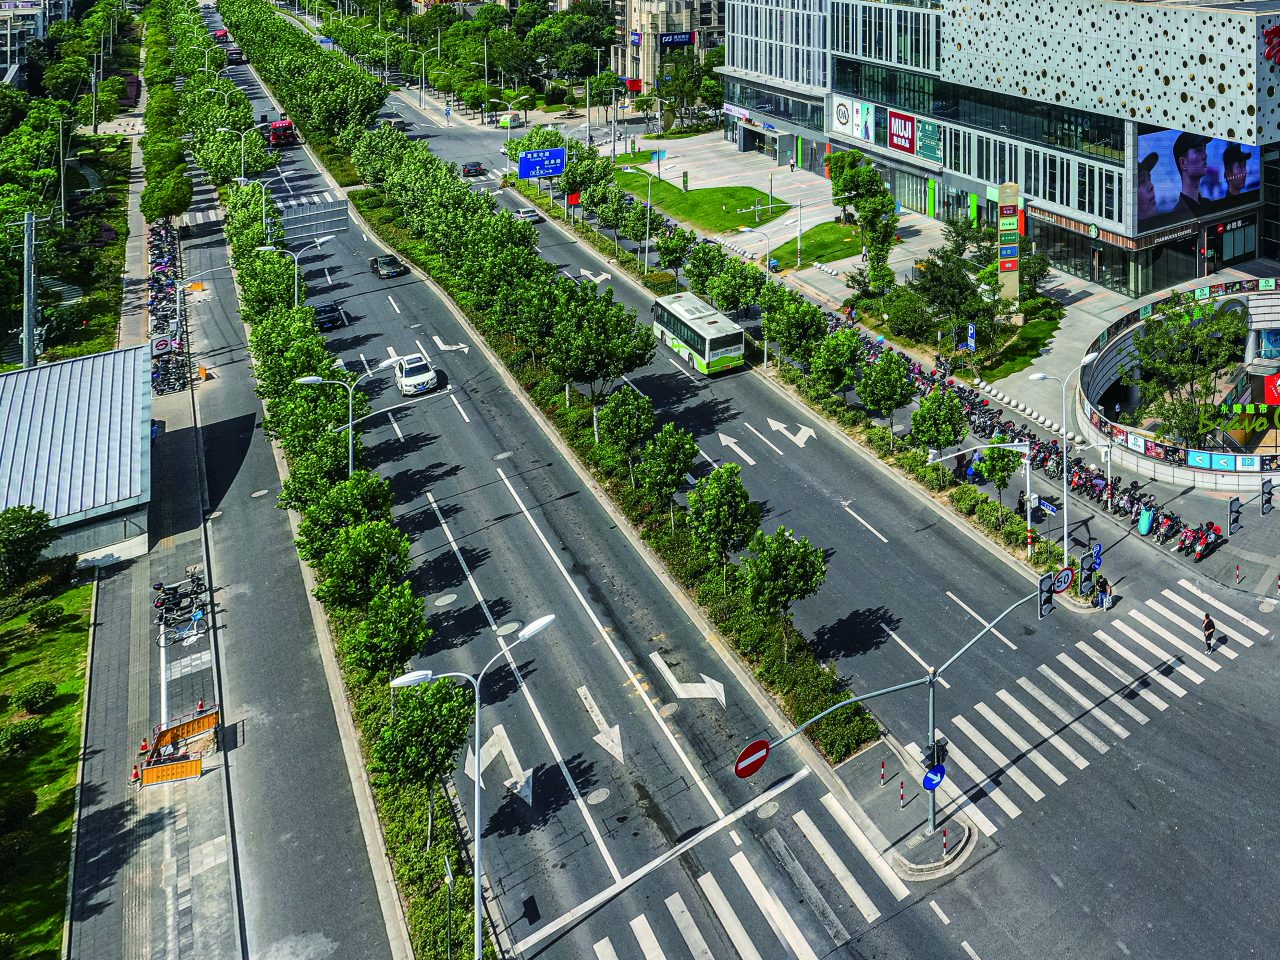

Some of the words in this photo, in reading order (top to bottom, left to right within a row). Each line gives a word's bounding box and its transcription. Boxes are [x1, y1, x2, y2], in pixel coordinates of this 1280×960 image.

[891, 117, 912, 139] MUJI
[1154, 233, 1177, 244] STARBUCKS
[1177, 228, 1192, 238] COFFEE
[1220, 403, 1268, 414] 永辉超市
[1197, 403, 1271, 435] Bravo
[1056, 573, 1070, 588] 50
